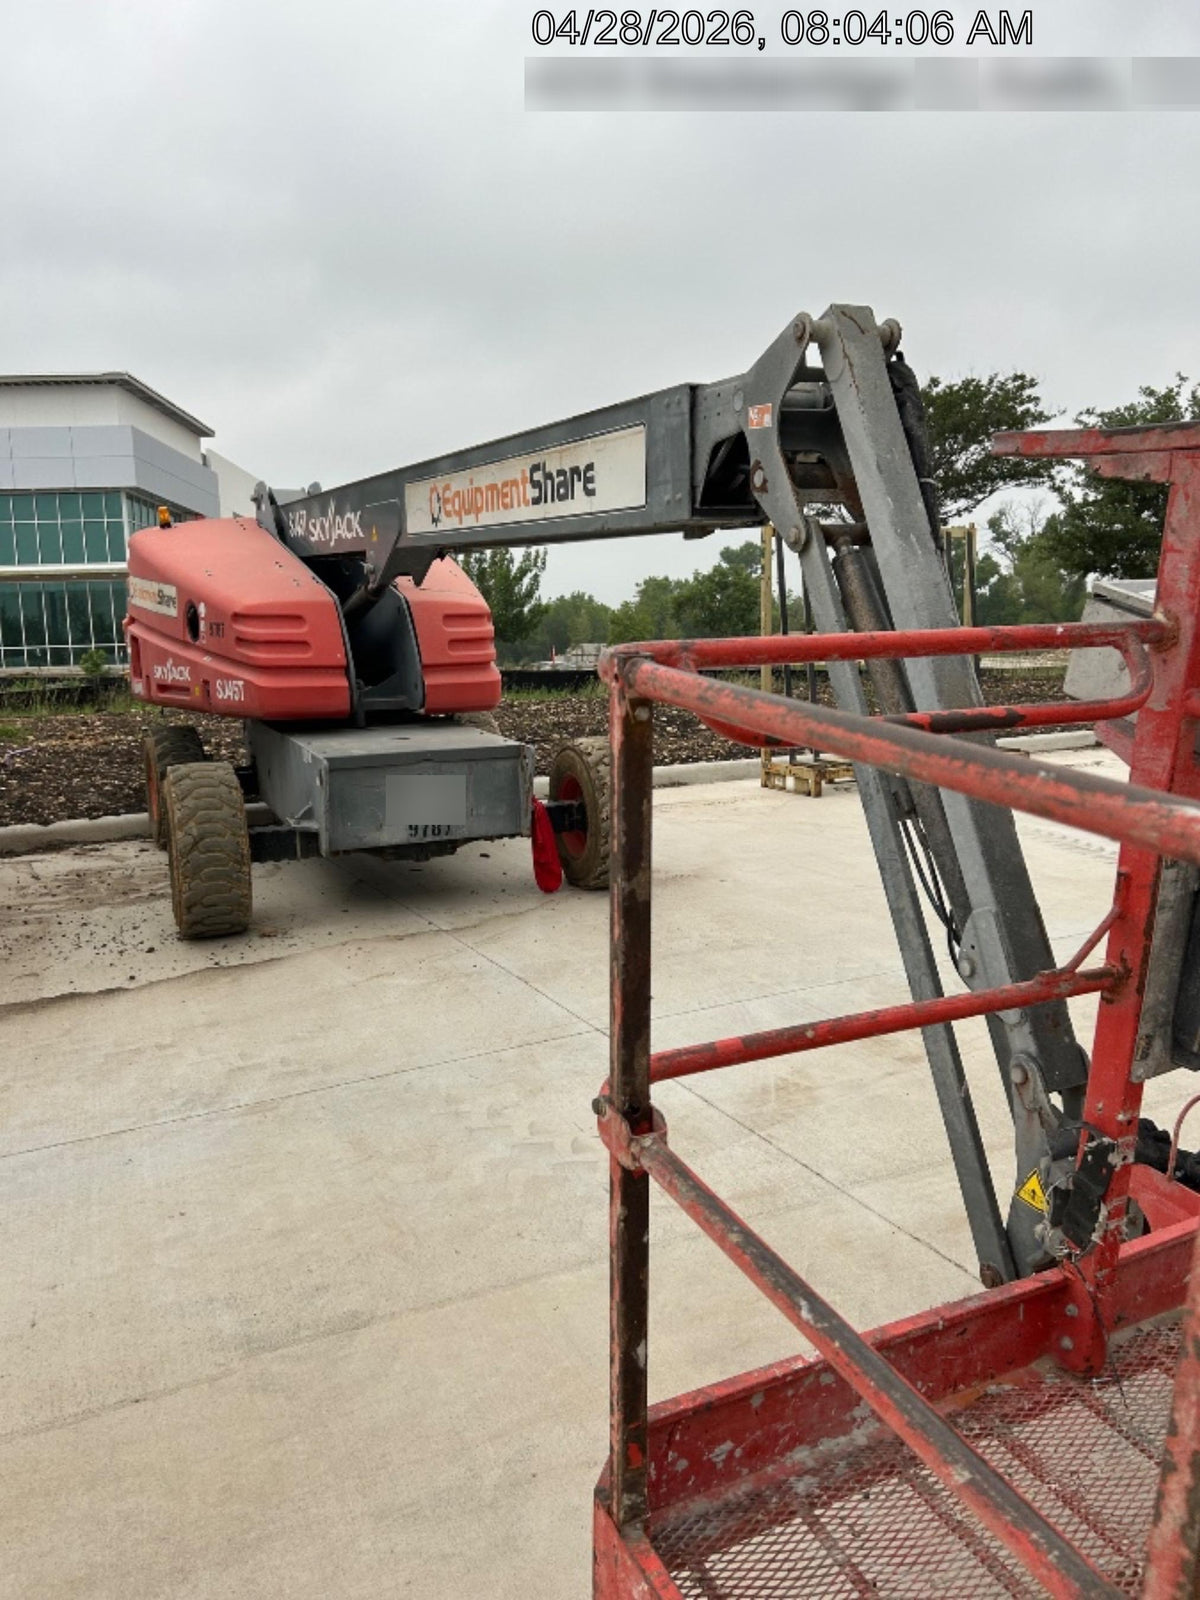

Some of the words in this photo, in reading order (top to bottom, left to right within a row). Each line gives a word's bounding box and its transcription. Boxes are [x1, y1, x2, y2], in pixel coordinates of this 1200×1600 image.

[441, 460, 596, 525] EquipmentShare
[309, 497, 365, 547] SKYJACK
[153, 658, 191, 683] SKYJACK
[216, 679, 245, 702] SJ45T
